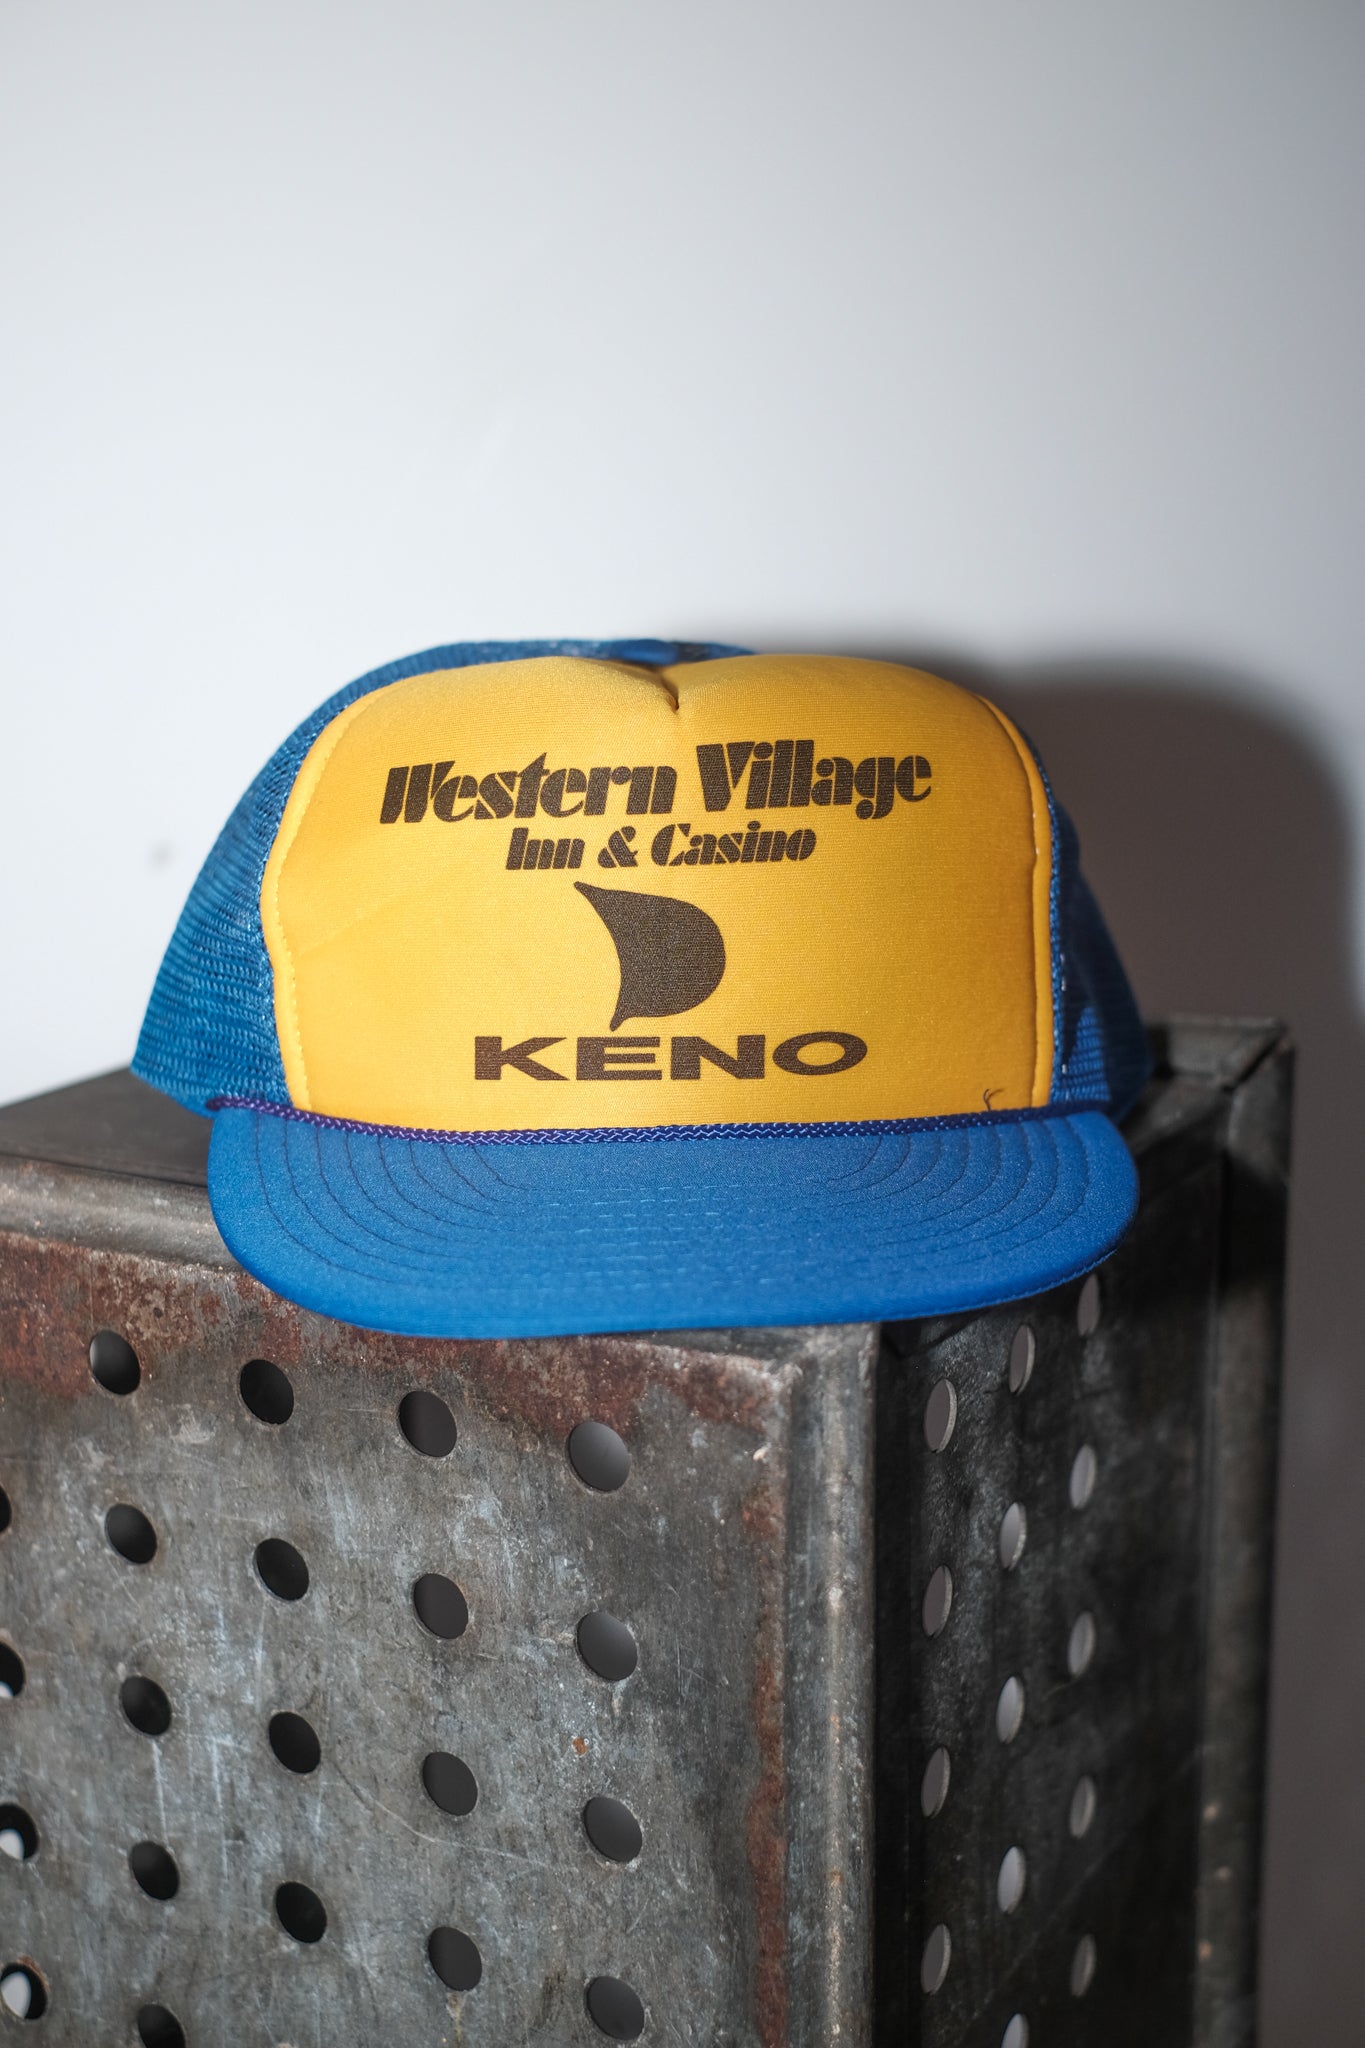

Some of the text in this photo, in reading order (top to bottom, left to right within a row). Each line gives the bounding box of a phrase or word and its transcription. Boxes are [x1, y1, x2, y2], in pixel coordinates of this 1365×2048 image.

[380, 739, 932, 824] Western Village
[505, 820, 817, 870] Inn & Casino
[474, 1030, 868, 1081] KENO
